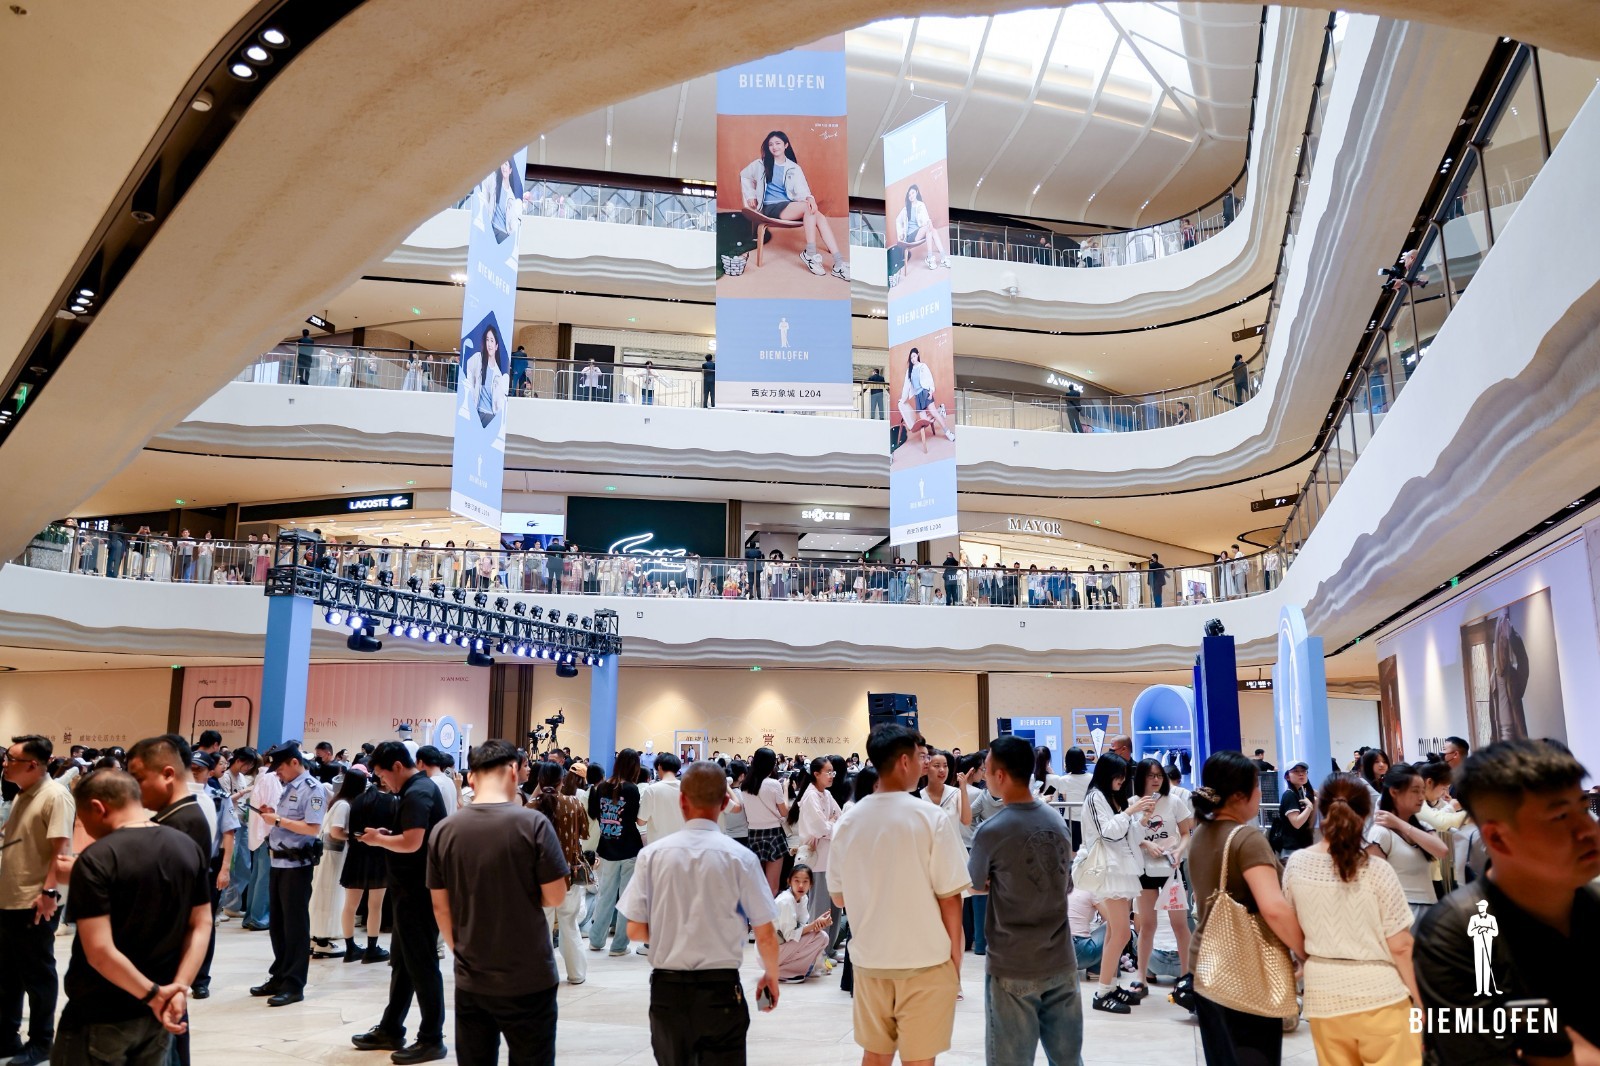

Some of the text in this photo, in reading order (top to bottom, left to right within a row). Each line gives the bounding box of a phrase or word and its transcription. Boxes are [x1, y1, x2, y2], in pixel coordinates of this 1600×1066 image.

[739, 74, 825, 90] BIEMLOFEN
[760, 351, 809, 361] BIEMLOFEN
[751, 389, 821, 398] 西安万象城 L204
[350, 499, 389, 509] LACOSTE
[802, 508, 834, 522] SHOKZ
[1008, 518, 1062, 535] MAYOR
